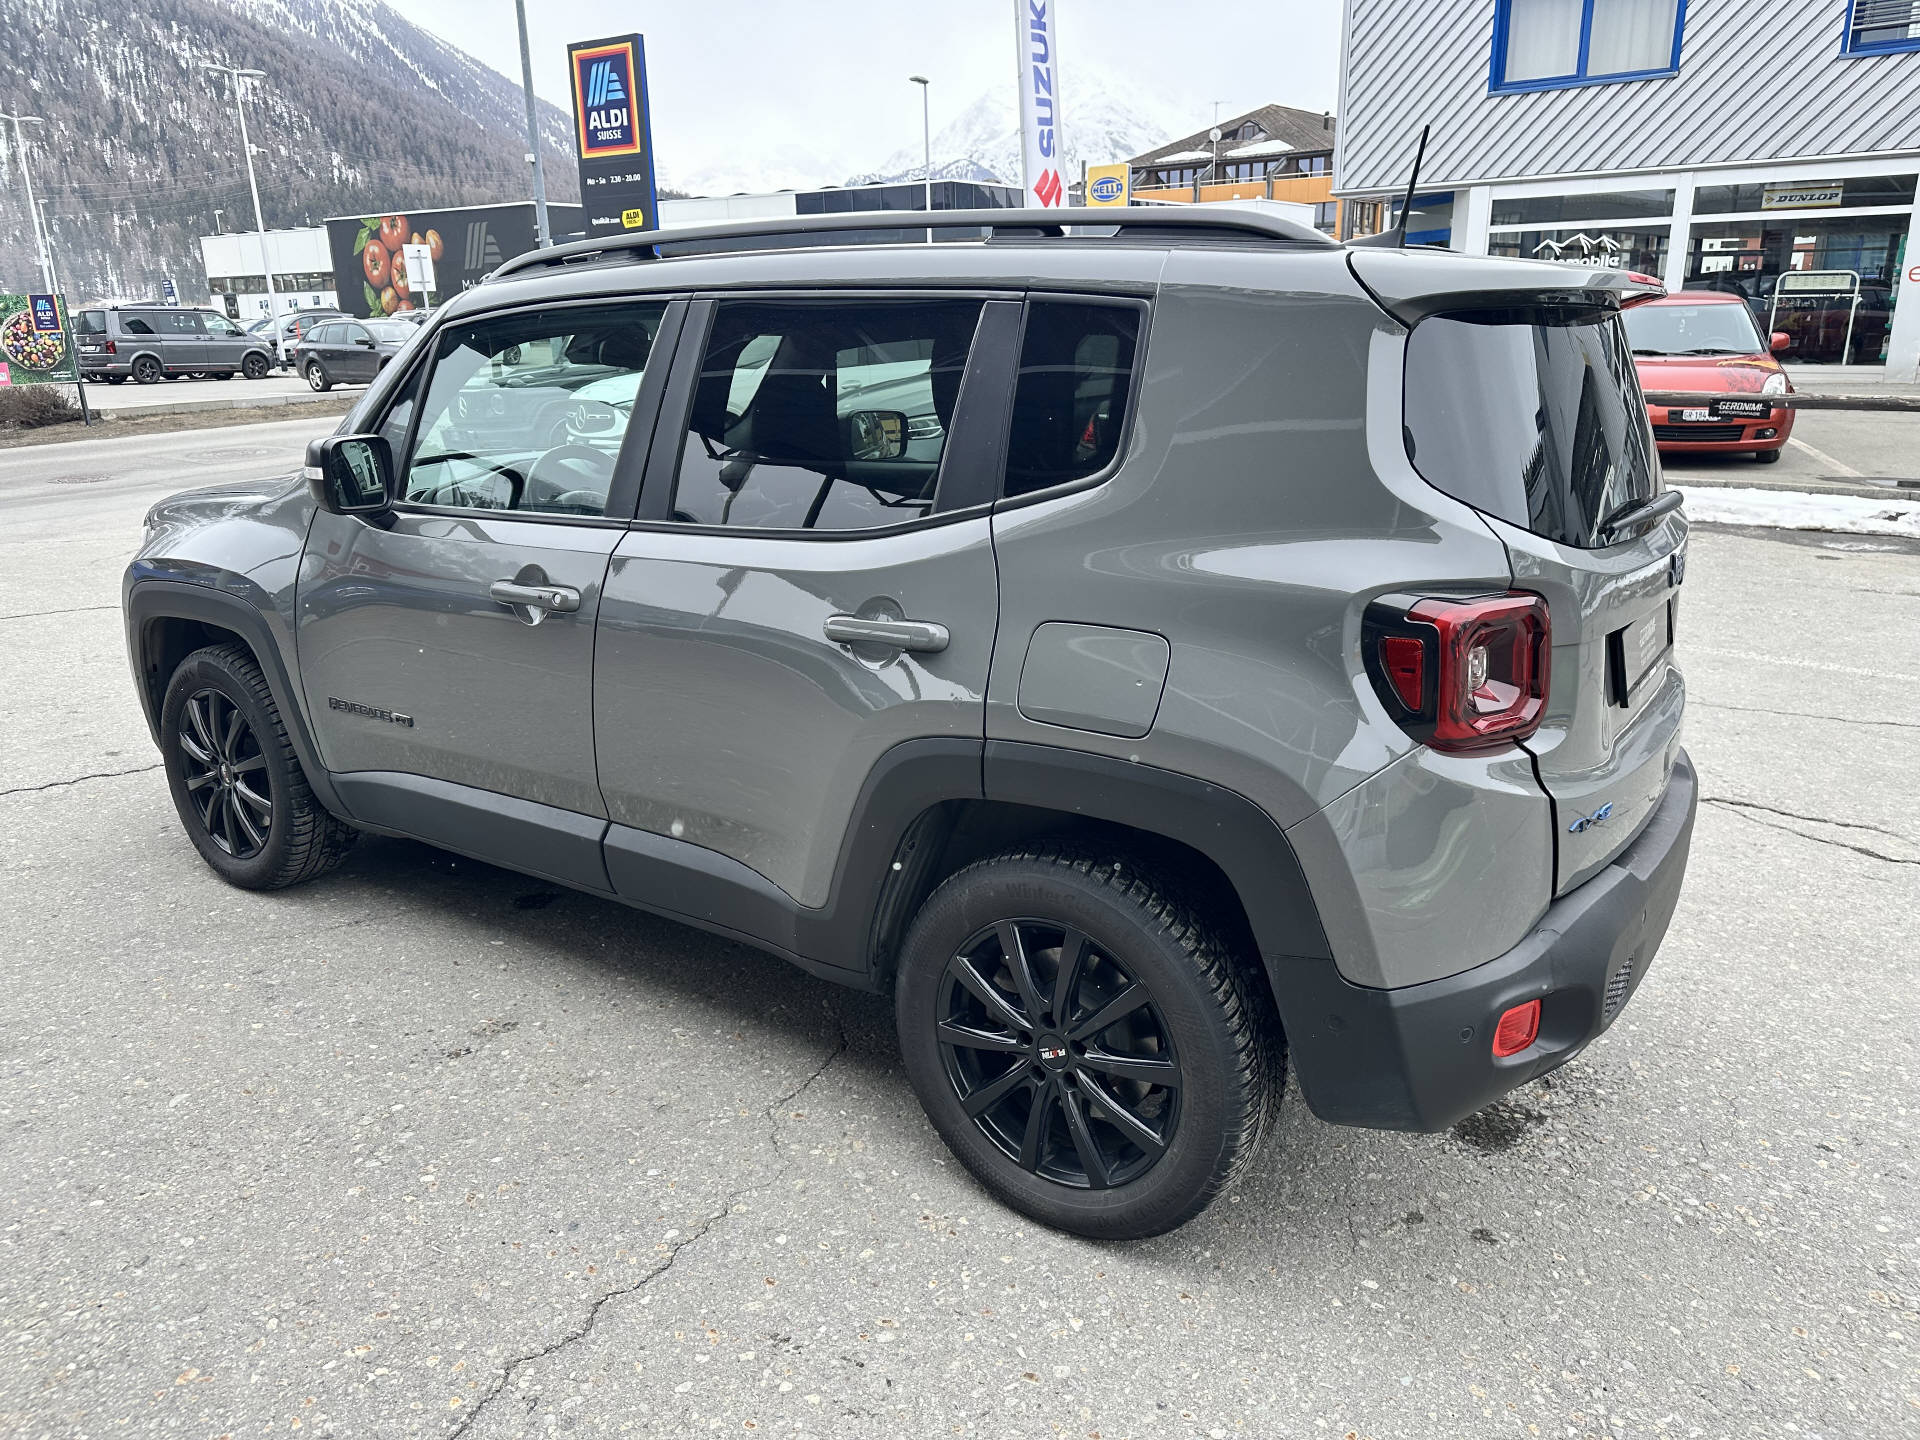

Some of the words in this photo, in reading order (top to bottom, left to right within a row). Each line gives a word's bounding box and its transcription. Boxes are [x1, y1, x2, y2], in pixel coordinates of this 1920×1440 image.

[589, 108, 628, 129] ALDI
[597, 129, 622, 141] SUISSE
[1093, 182, 1123, 195] HELLA
[1775, 192, 1840, 203] DUNLOP
[626, 211, 640, 220] ALDI
[328, 696, 393, 722] RENEGADE
